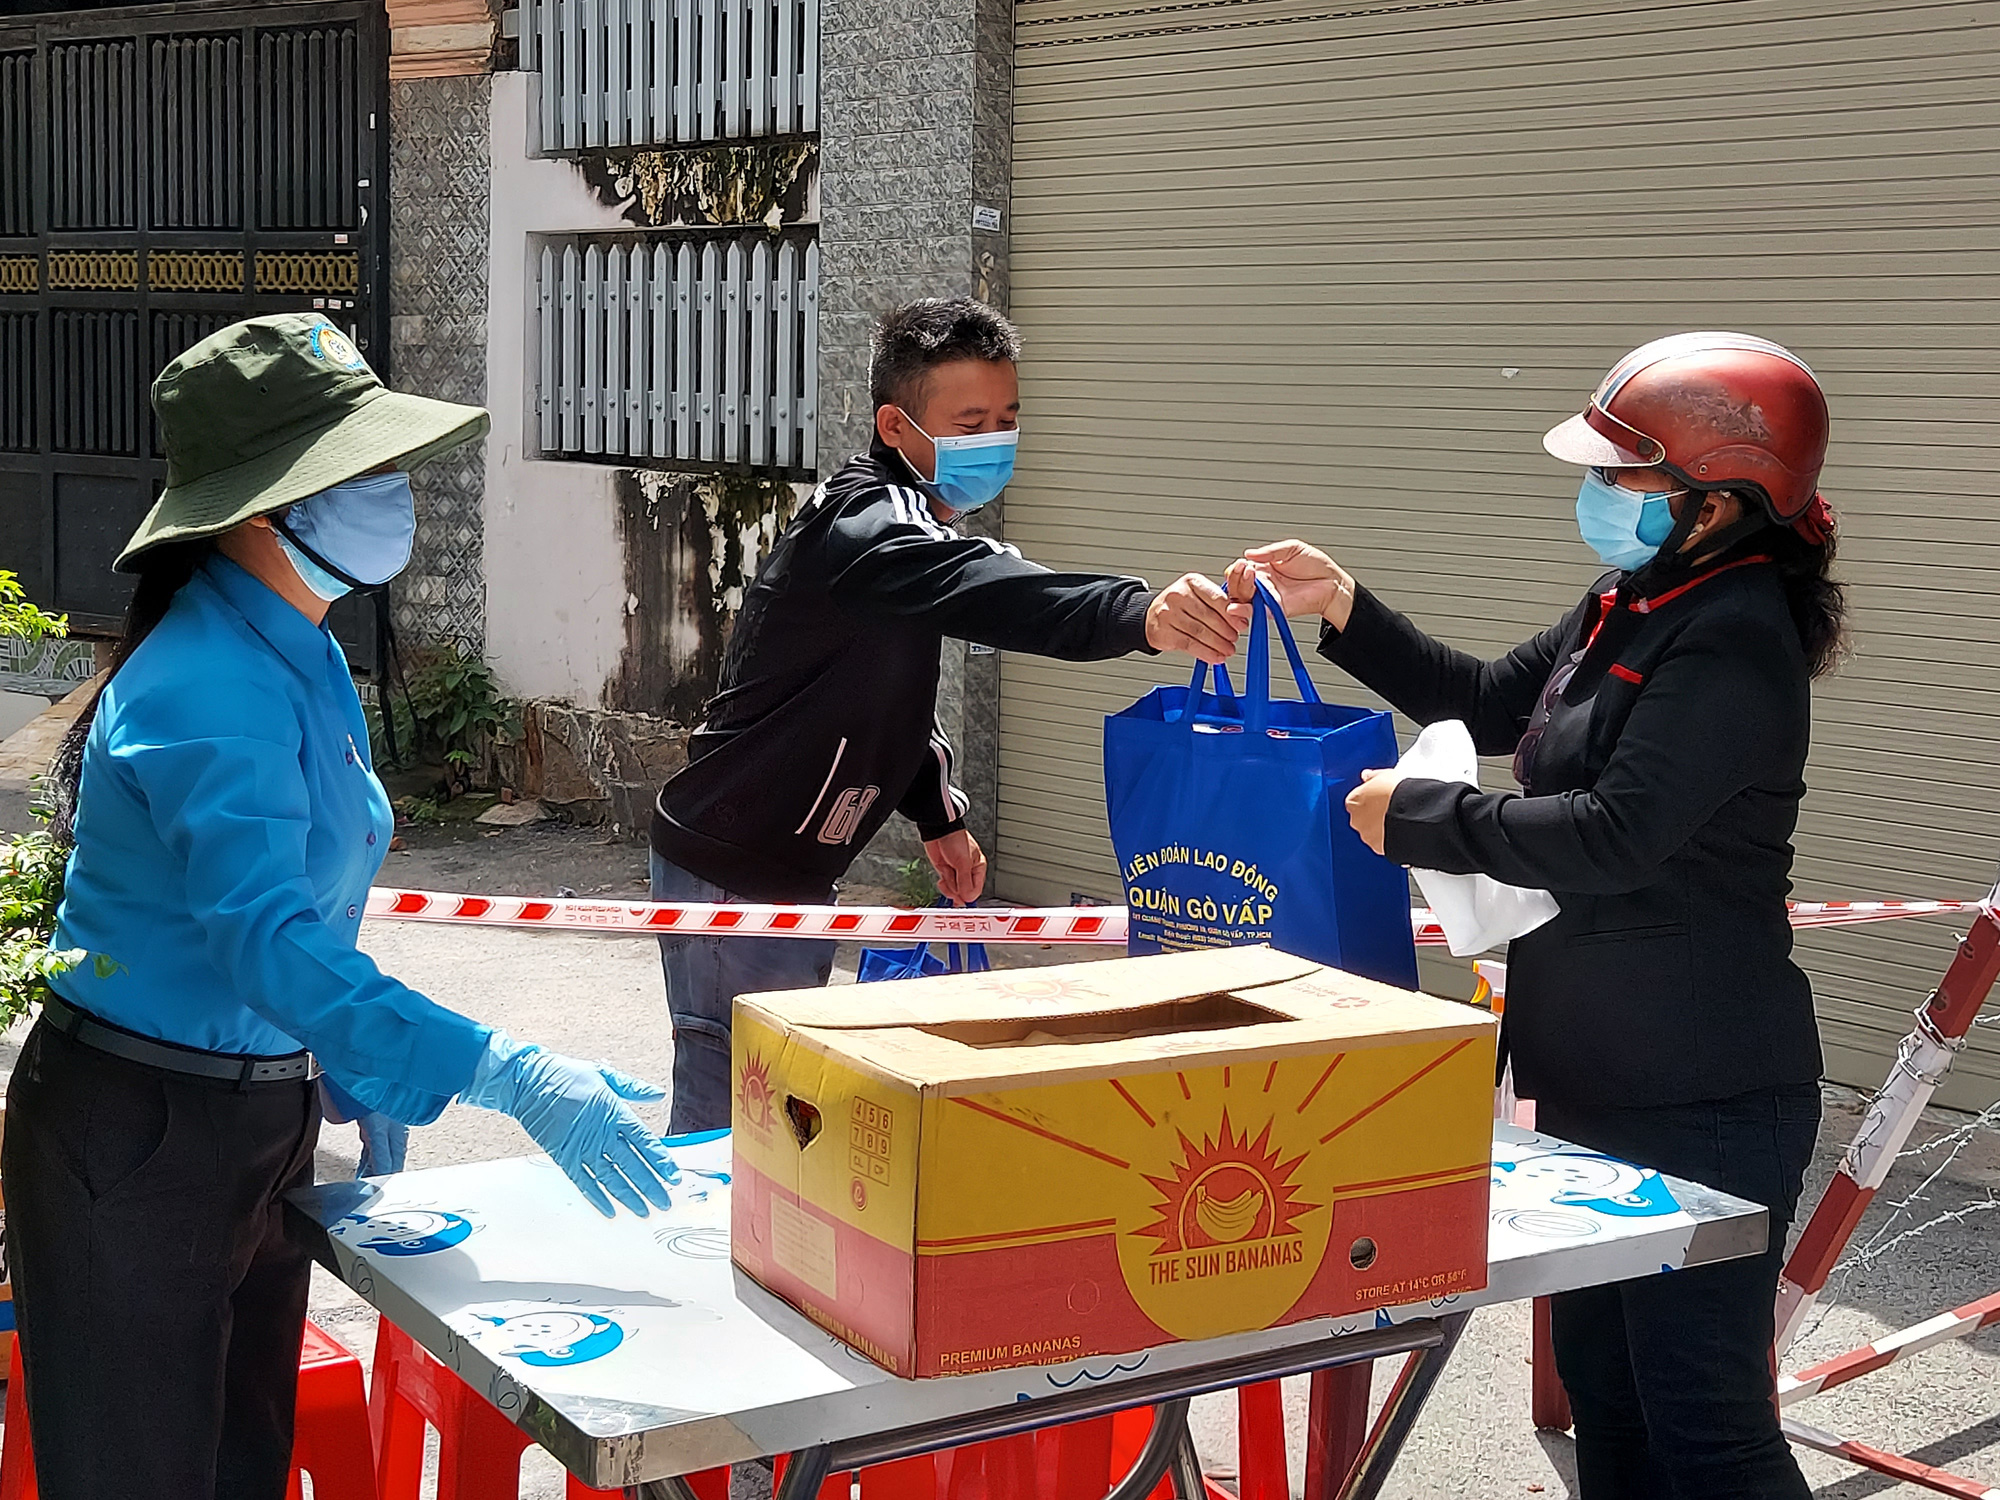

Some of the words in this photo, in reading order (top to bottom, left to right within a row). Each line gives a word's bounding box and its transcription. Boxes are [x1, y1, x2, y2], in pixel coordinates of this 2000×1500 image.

[1124, 853, 1160, 883] LIÊN
[1194, 848, 1228, 873] LAO
[1230, 859, 1279, 903] ĐỘNG
[1128, 886, 1180, 917] QUẬN
[1186, 894, 1218, 922] GÒ
[1221, 895, 1273, 925] VẤP
[1148, 1257, 1180, 1286] THE
[1186, 1254, 1221, 1280] SUN
[1225, 1240, 1304, 1274] BANANAS
[1355, 1284, 1390, 1301] STORE
[1392, 1281, 1405, 1295] AT
[1431, 1273, 1446, 1287] OR
[940, 1346, 1008, 1368] PREMIUM
[1012, 1334, 1082, 1358] BANANAS
